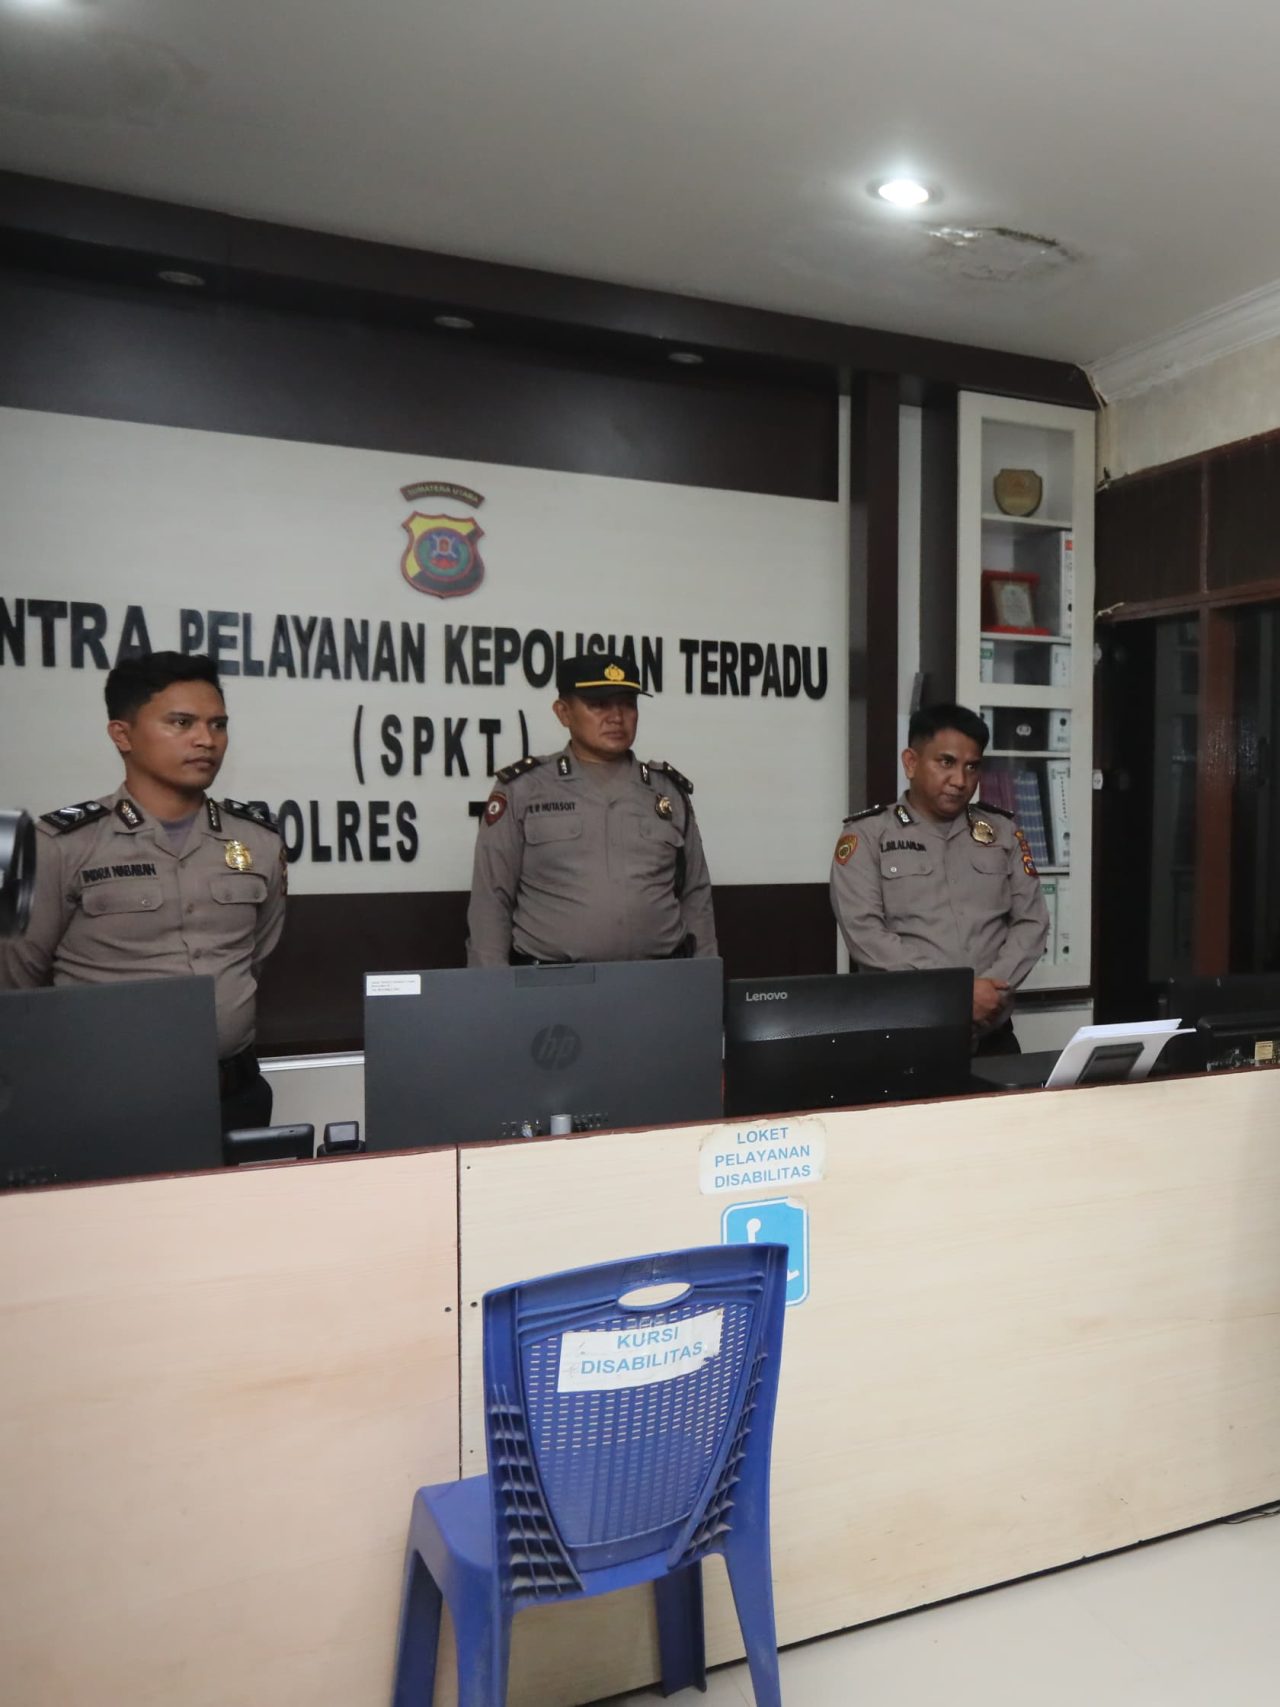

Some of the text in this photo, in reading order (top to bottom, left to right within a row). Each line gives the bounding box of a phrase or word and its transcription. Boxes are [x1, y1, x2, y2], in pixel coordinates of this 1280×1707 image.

[180, 608, 426, 683] PELAYANAN
[679, 638, 828, 701] TERPADU
[746, 990, 788, 1002] Lenovo
[736, 1127, 789, 1144] LOKET
[714, 1145, 811, 1167] PELAYANAN
[714, 1165, 811, 1188] DISABILITAS
[617, 1327, 679, 1349] KURSI
[581, 1341, 703, 1375] DISABILITAS
